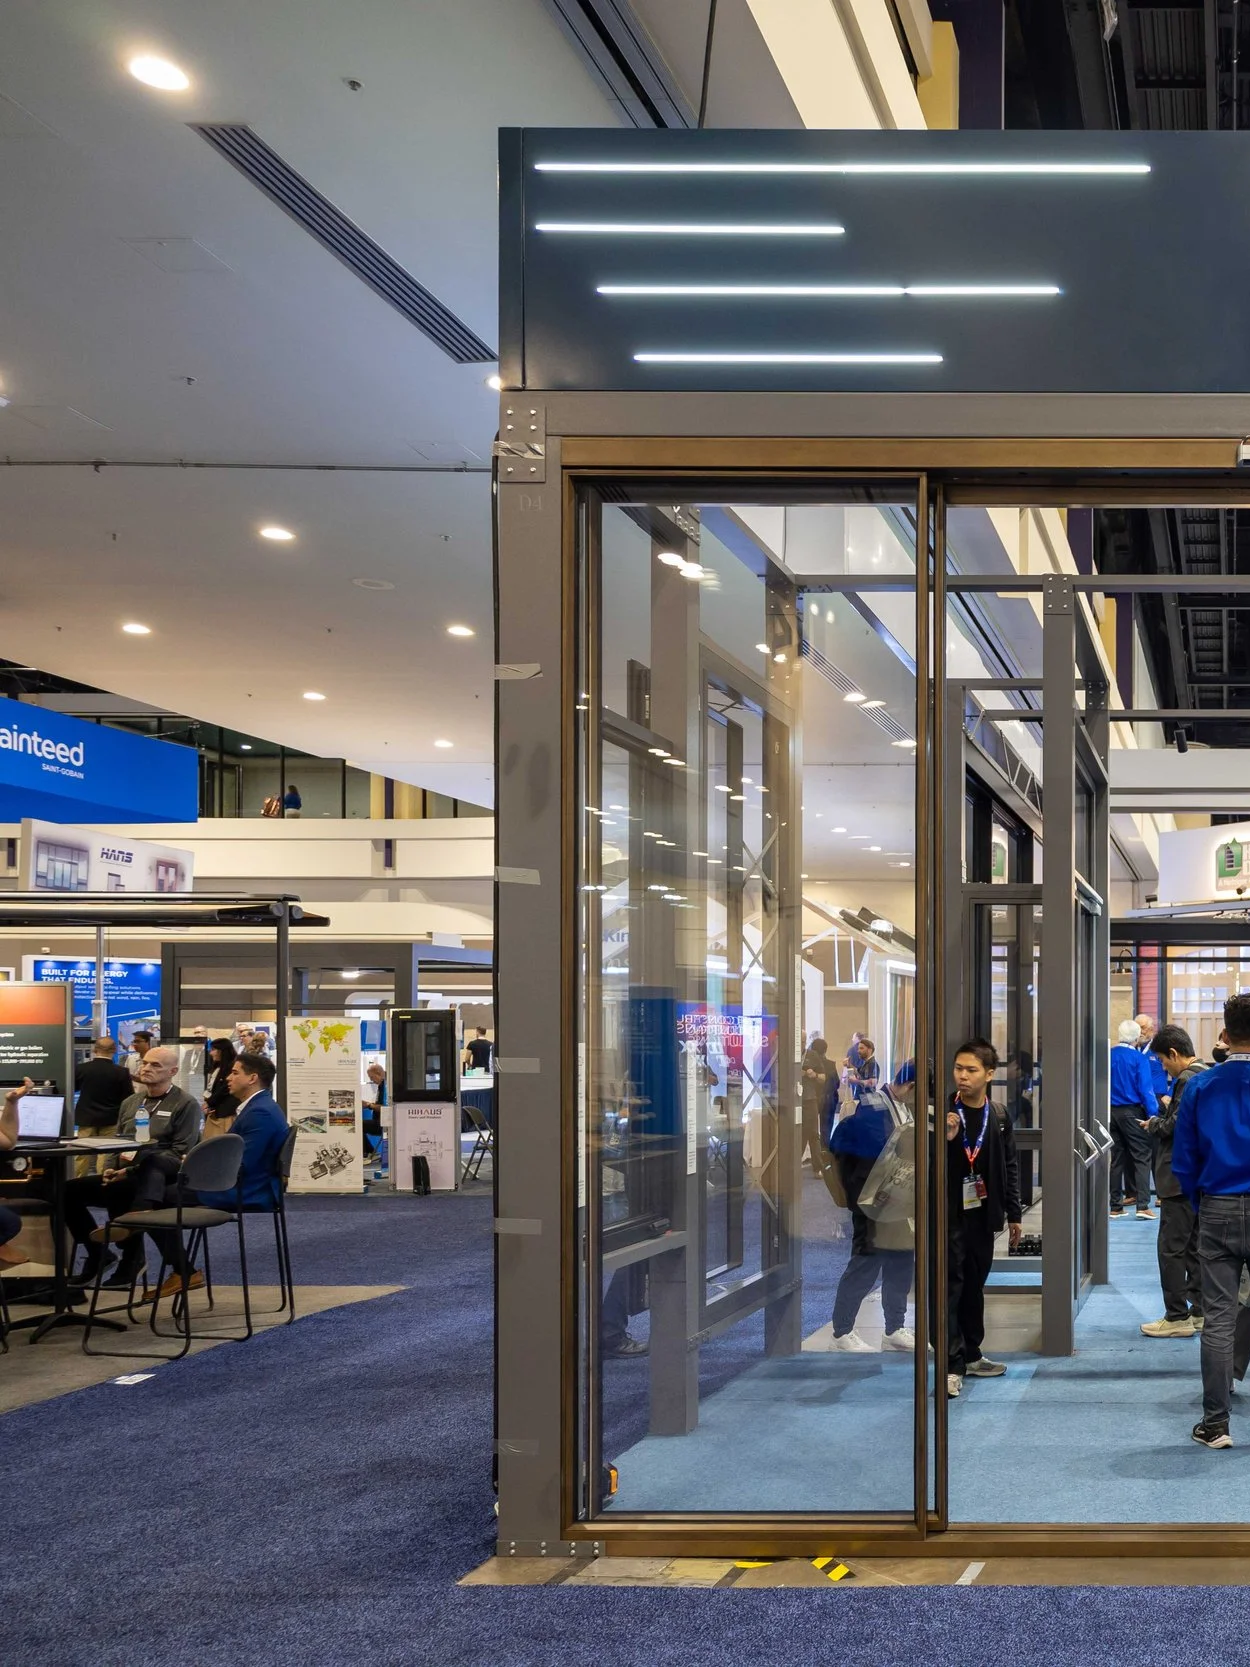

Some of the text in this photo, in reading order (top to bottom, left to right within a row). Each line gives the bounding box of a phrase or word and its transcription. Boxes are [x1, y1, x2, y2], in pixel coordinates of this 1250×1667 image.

[41, 763, 85, 779] SAINT-GOBAIN
[41, 968, 129, 978] BUILT FOR EERGY
